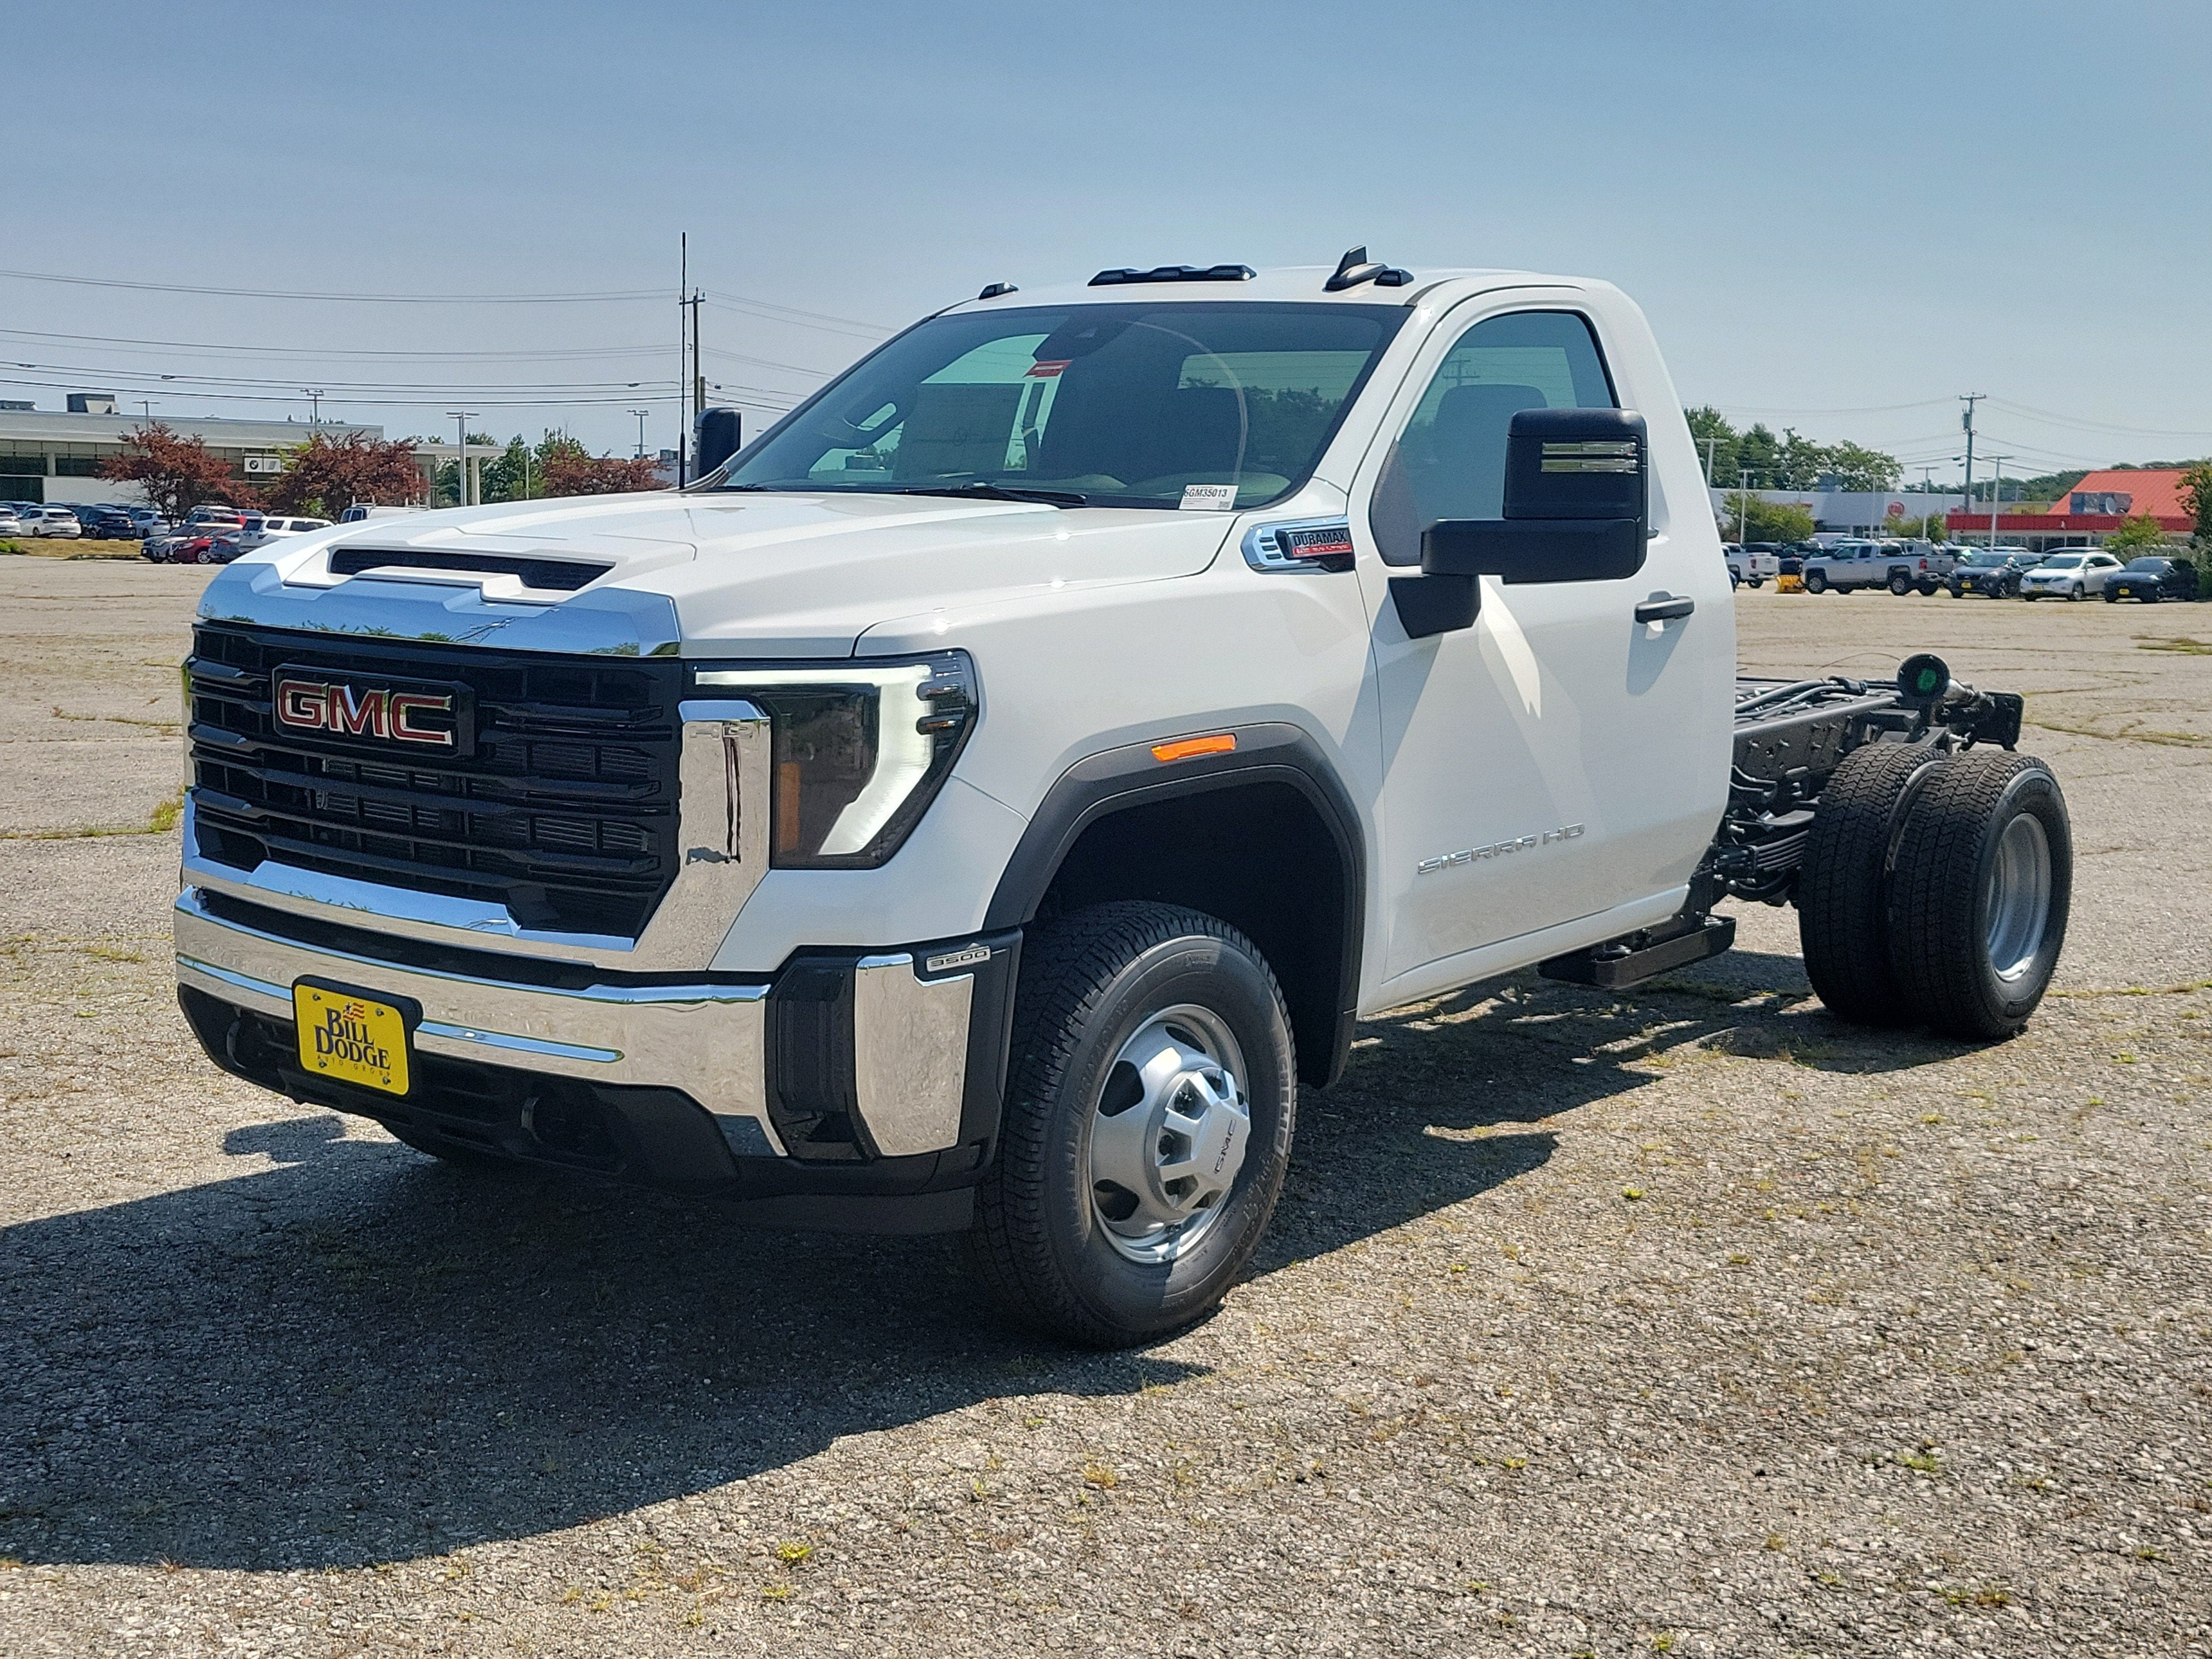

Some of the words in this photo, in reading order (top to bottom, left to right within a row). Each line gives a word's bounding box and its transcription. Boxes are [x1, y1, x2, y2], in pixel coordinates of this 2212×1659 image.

[1293, 531, 1346, 546] DURAMAX
[278, 679, 453, 746] GMC
[1418, 834, 1537, 874] SIERRA
[1543, 822, 1585, 845] HD
[930, 951, 988, 967] 3500
[314, 1024, 392, 1070] DODGE
[325, 1007, 375, 1048] BILL
[1214, 1118, 1237, 1174] GMC
